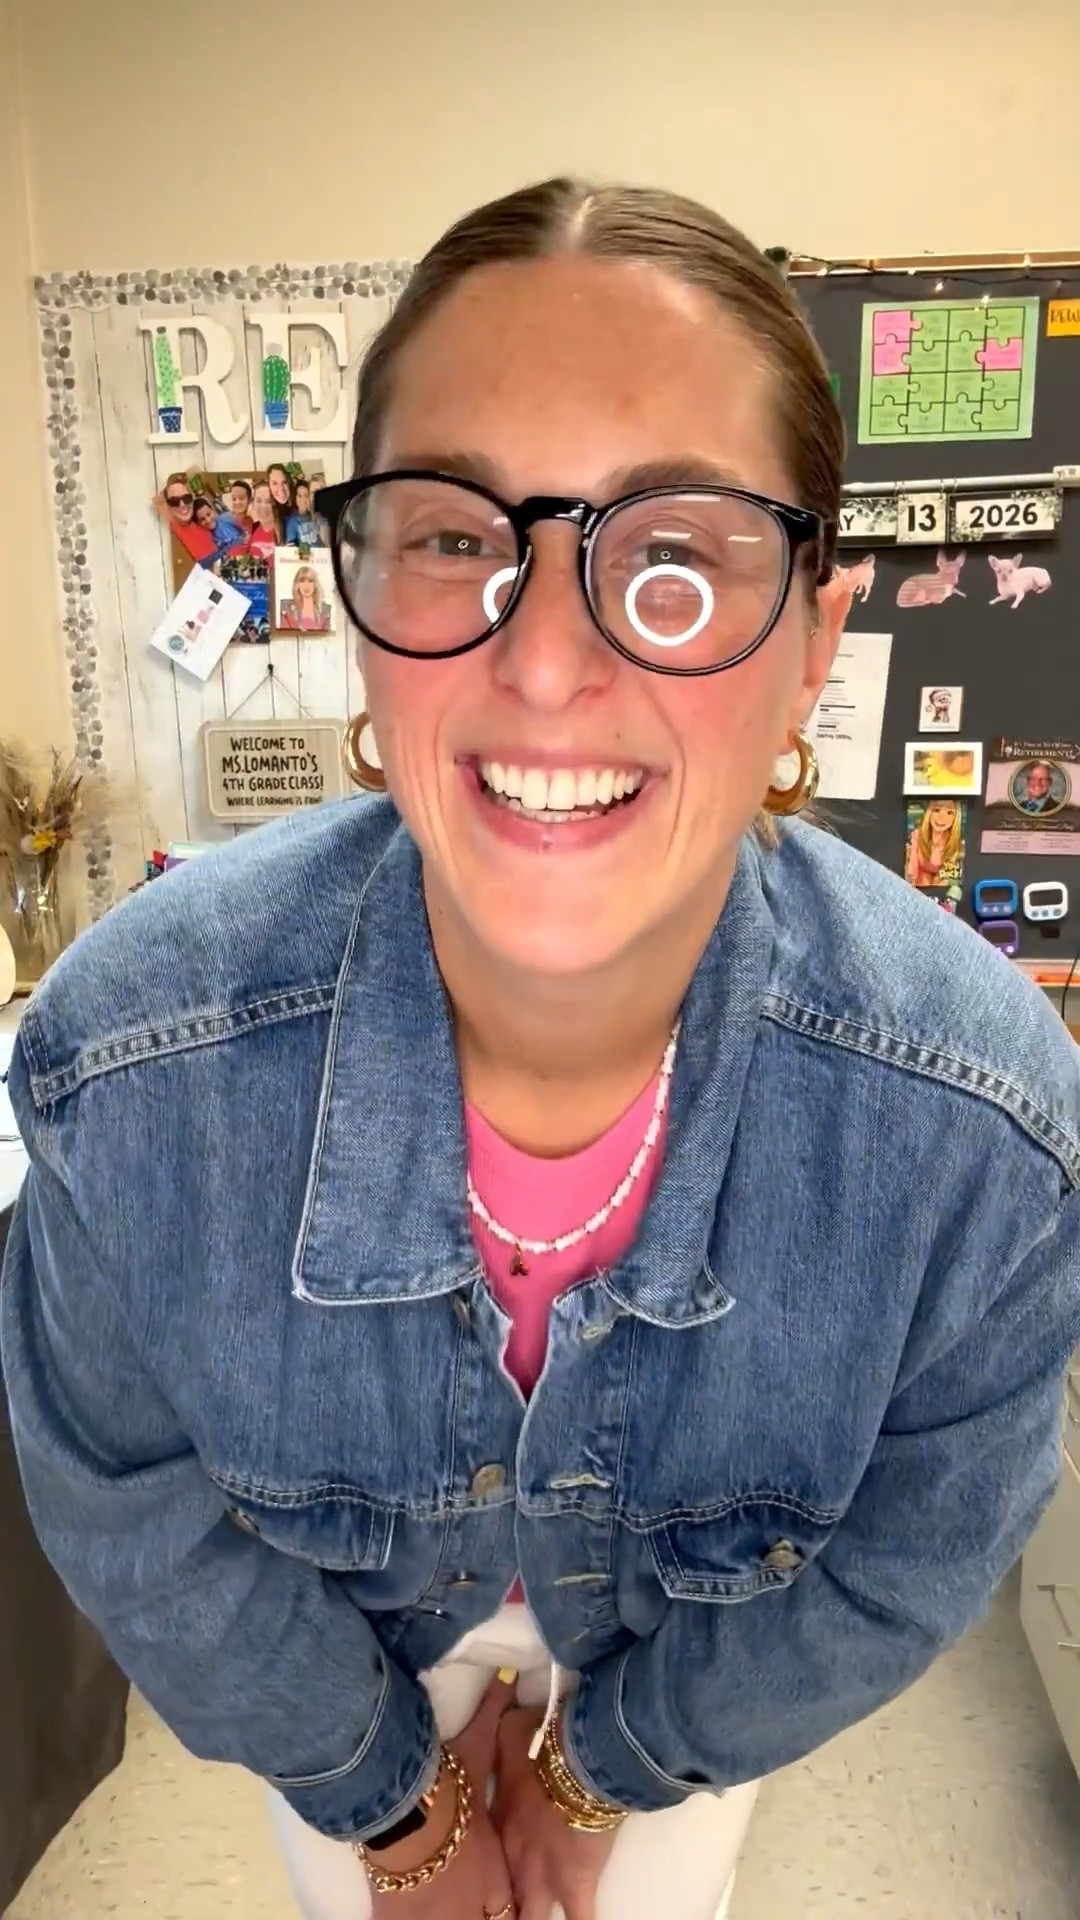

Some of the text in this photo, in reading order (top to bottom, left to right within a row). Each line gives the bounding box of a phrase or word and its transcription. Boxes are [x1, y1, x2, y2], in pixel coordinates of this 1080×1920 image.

[908, 504, 937, 532] 13
[969, 502, 1038, 529] 2026
[230, 736, 305, 752] WELCOME TO
[222, 774, 324, 792] 4TH GRADE CLASS!
[227, 796, 255, 807] WHERE
[256, 796, 294, 806] LEARNING
